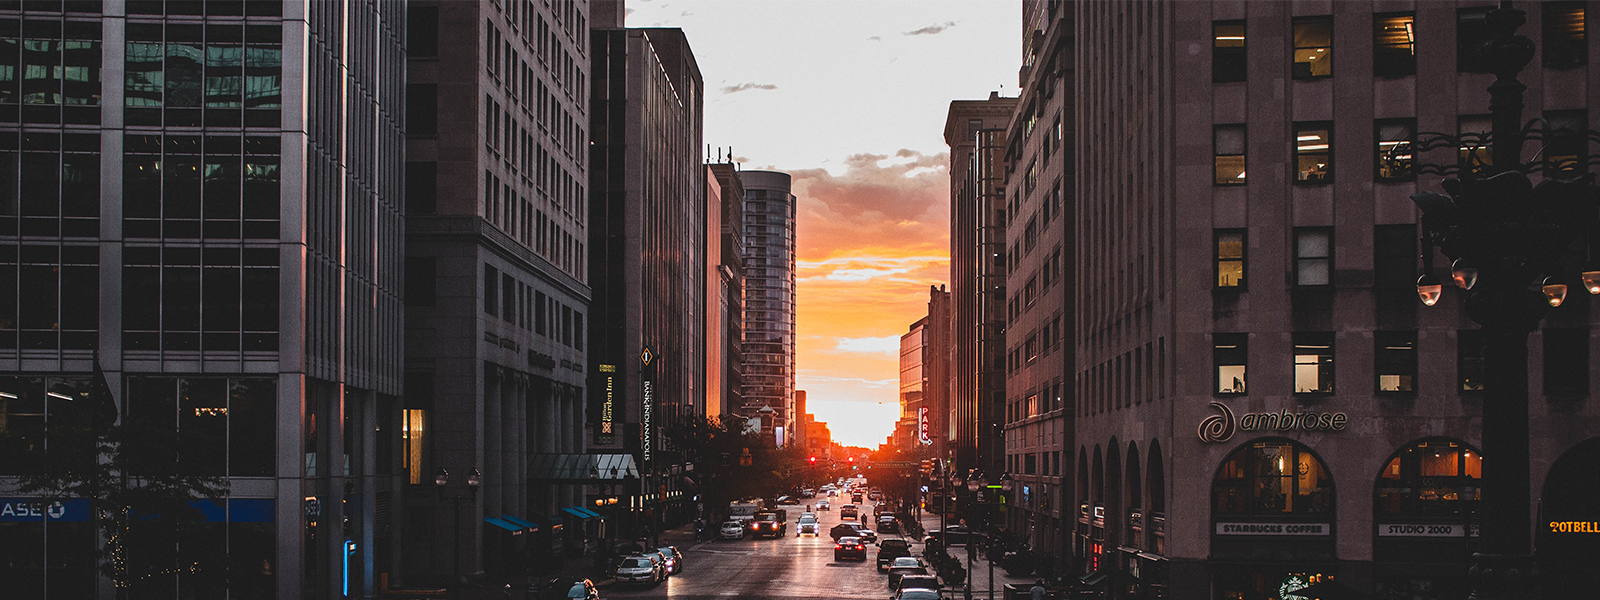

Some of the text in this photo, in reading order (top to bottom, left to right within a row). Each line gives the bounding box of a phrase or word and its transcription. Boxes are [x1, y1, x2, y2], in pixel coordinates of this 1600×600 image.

[1240, 408, 1348, 431] ambrose
[1223, 524, 1323, 533] STARBUCKS COFFEE
[1389, 525, 1452, 534] STUDIO 2000
